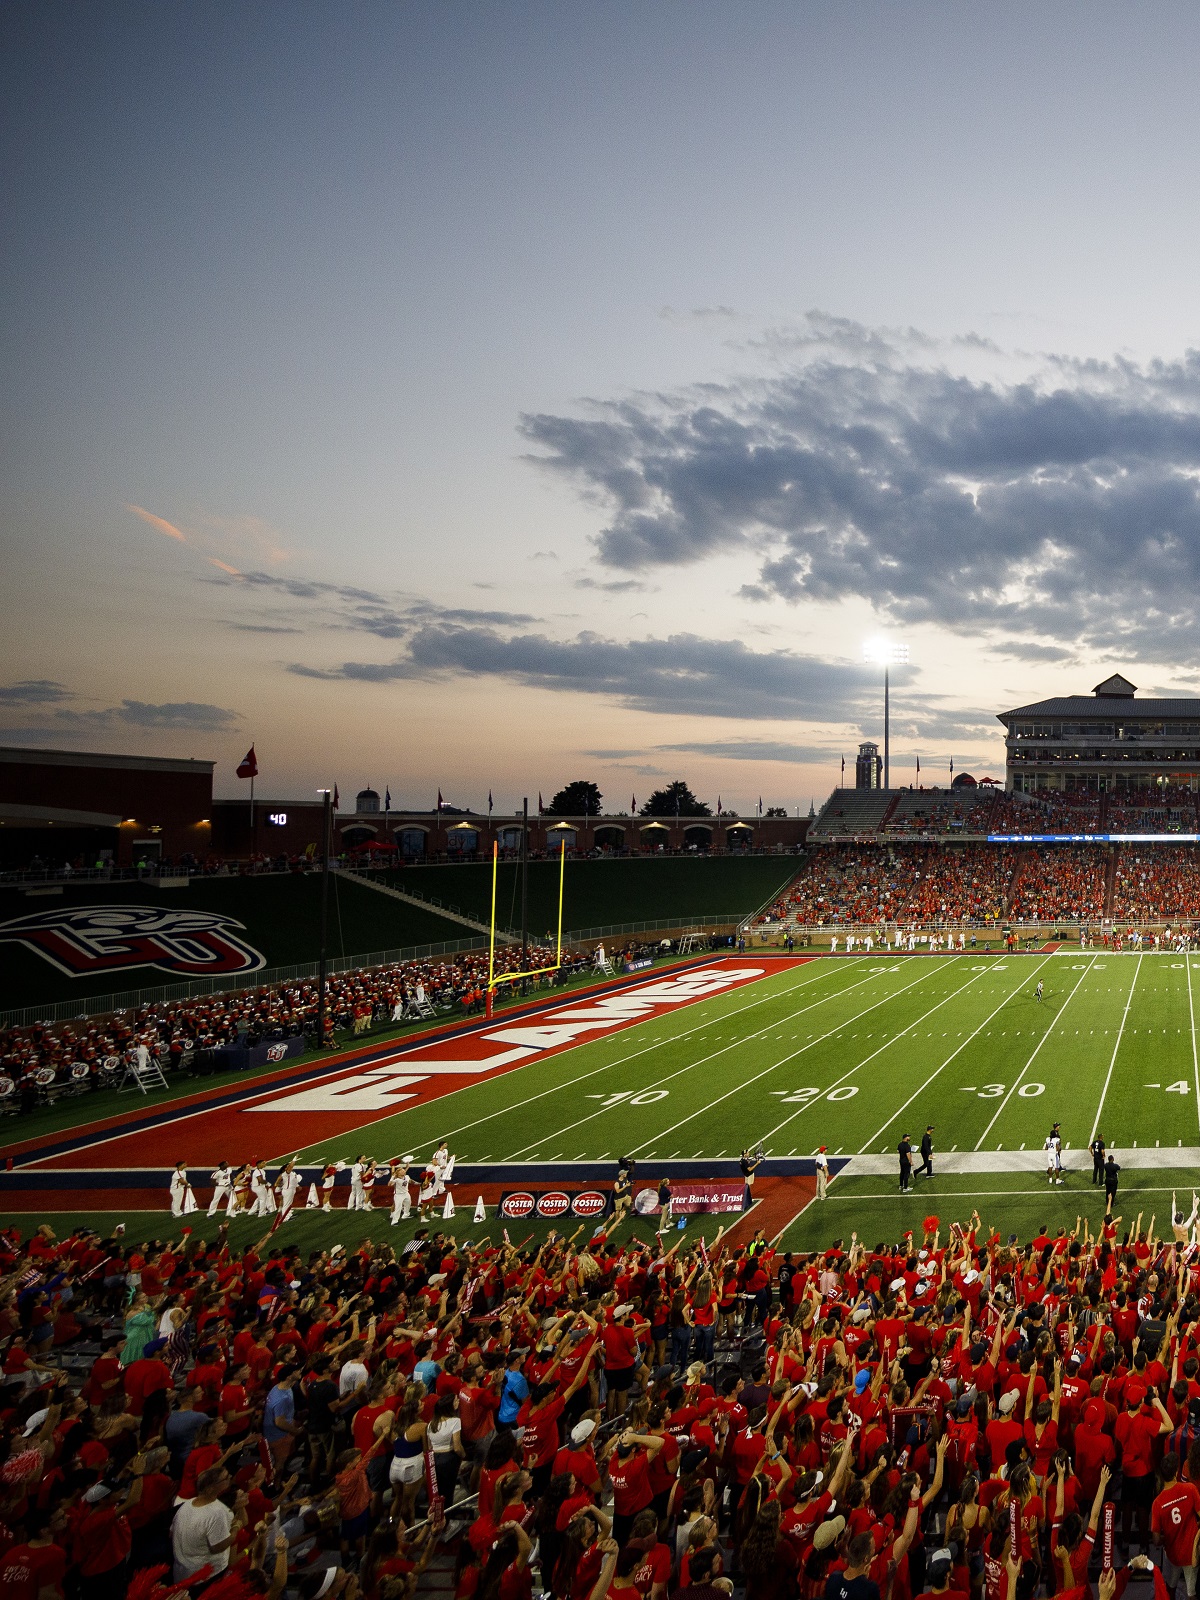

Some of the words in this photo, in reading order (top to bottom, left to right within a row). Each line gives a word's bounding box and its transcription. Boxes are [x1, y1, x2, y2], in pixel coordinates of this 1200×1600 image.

[270, 813, 287, 825] 40
[241, 968, 766, 1113] FLAMES
[779, 1086, 859, 1103] 20
[977, 1082, 1046, 1098] 30
[600, 1090, 670, 1106] 10
[504, 1199, 533, 1208] FOSTER
[539, 1199, 568, 1208] FOSTER
[574, 1199, 603, 1207] FOSTER
[688, 1195, 710, 1203] Bank
[711, 1194, 720, 1203] &
[721, 1193, 744, 1202] Trust
[1104, 1509, 1113, 1530] RISE
[1170, 1507, 1182, 1525] 6
[1104, 1531, 1112, 1554] WITH
[1010, 1544, 1017, 1556] US
[1103, 1555, 1111, 1568] US
[839, 1587, 848, 1599] LU
